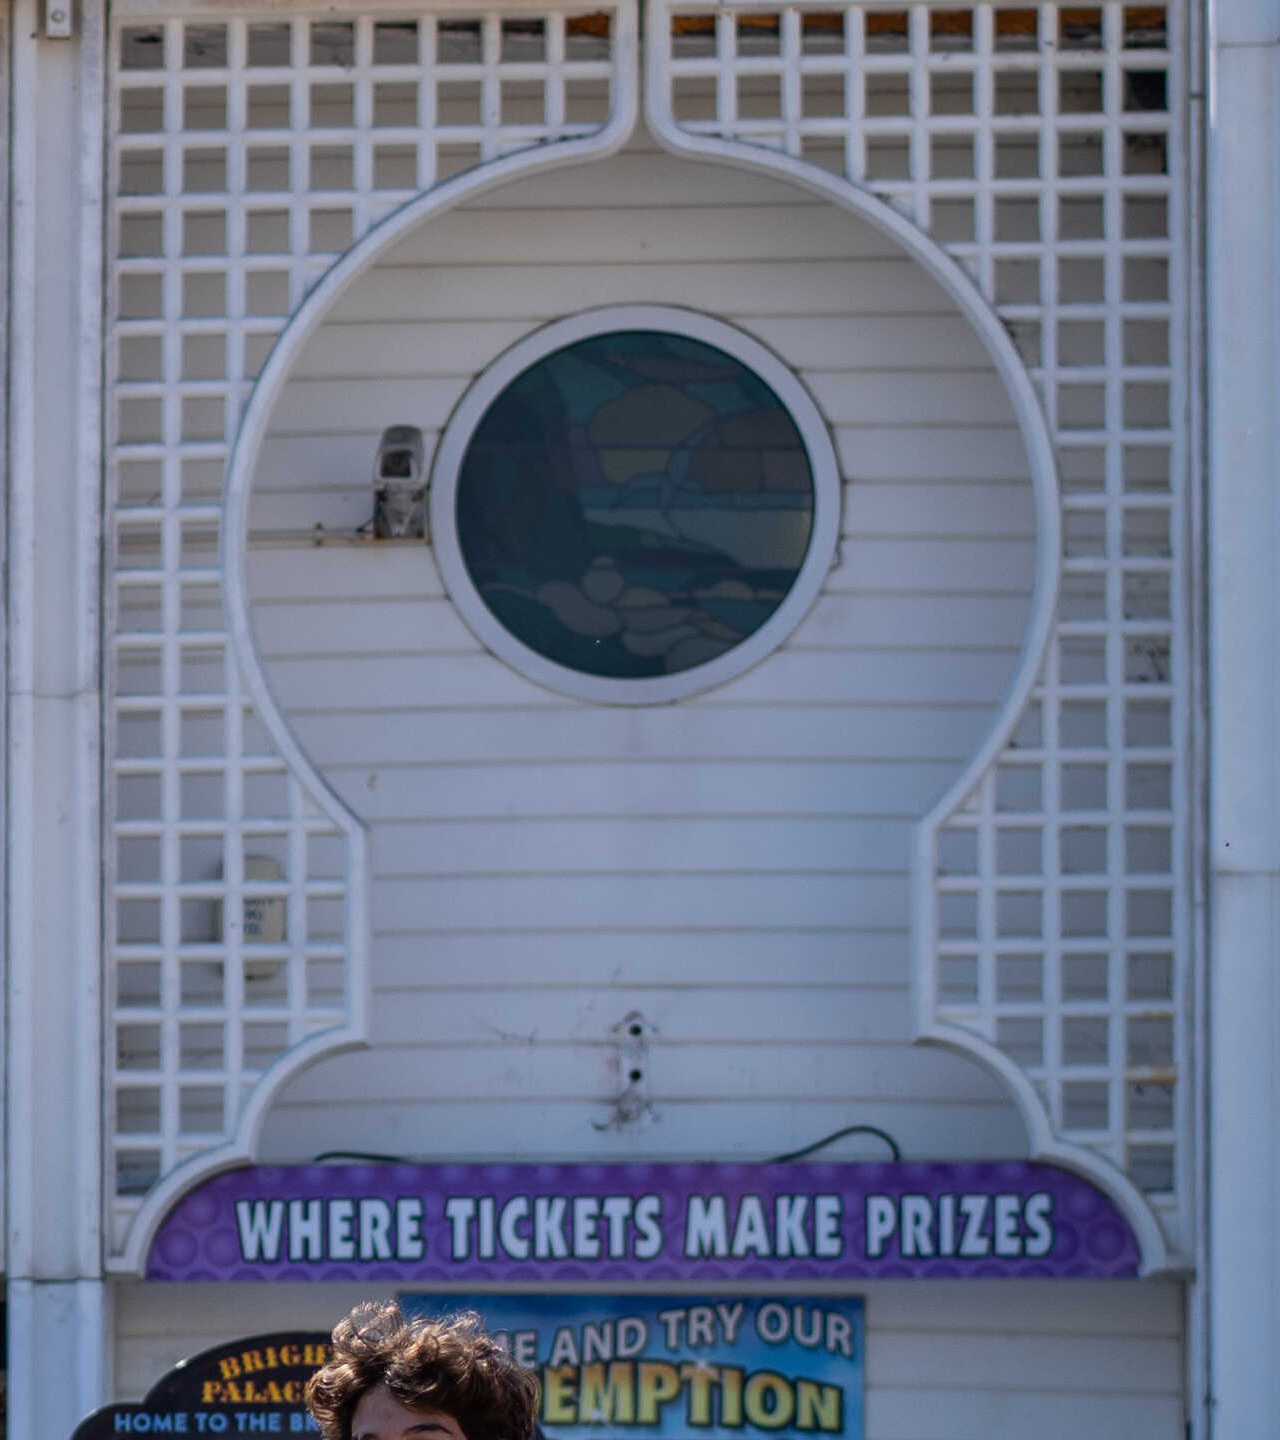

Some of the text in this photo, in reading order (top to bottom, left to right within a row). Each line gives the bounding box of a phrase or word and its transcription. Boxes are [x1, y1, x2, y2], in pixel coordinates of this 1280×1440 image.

[236, 1194, 1053, 1260] WHERE TICKETS MAKE PRIZES
[552, 1317, 647, 1366] AND
[659, 1303, 744, 1349] TRY
[756, 1303, 852, 1357] OUR
[114, 1412, 188, 1433] HOME
[195, 1412, 228, 1433] TO
[234, 1412, 281, 1433] THE
[201, 1379, 307, 1404] PALAC
[543, 1361, 844, 1433] EMPTION
